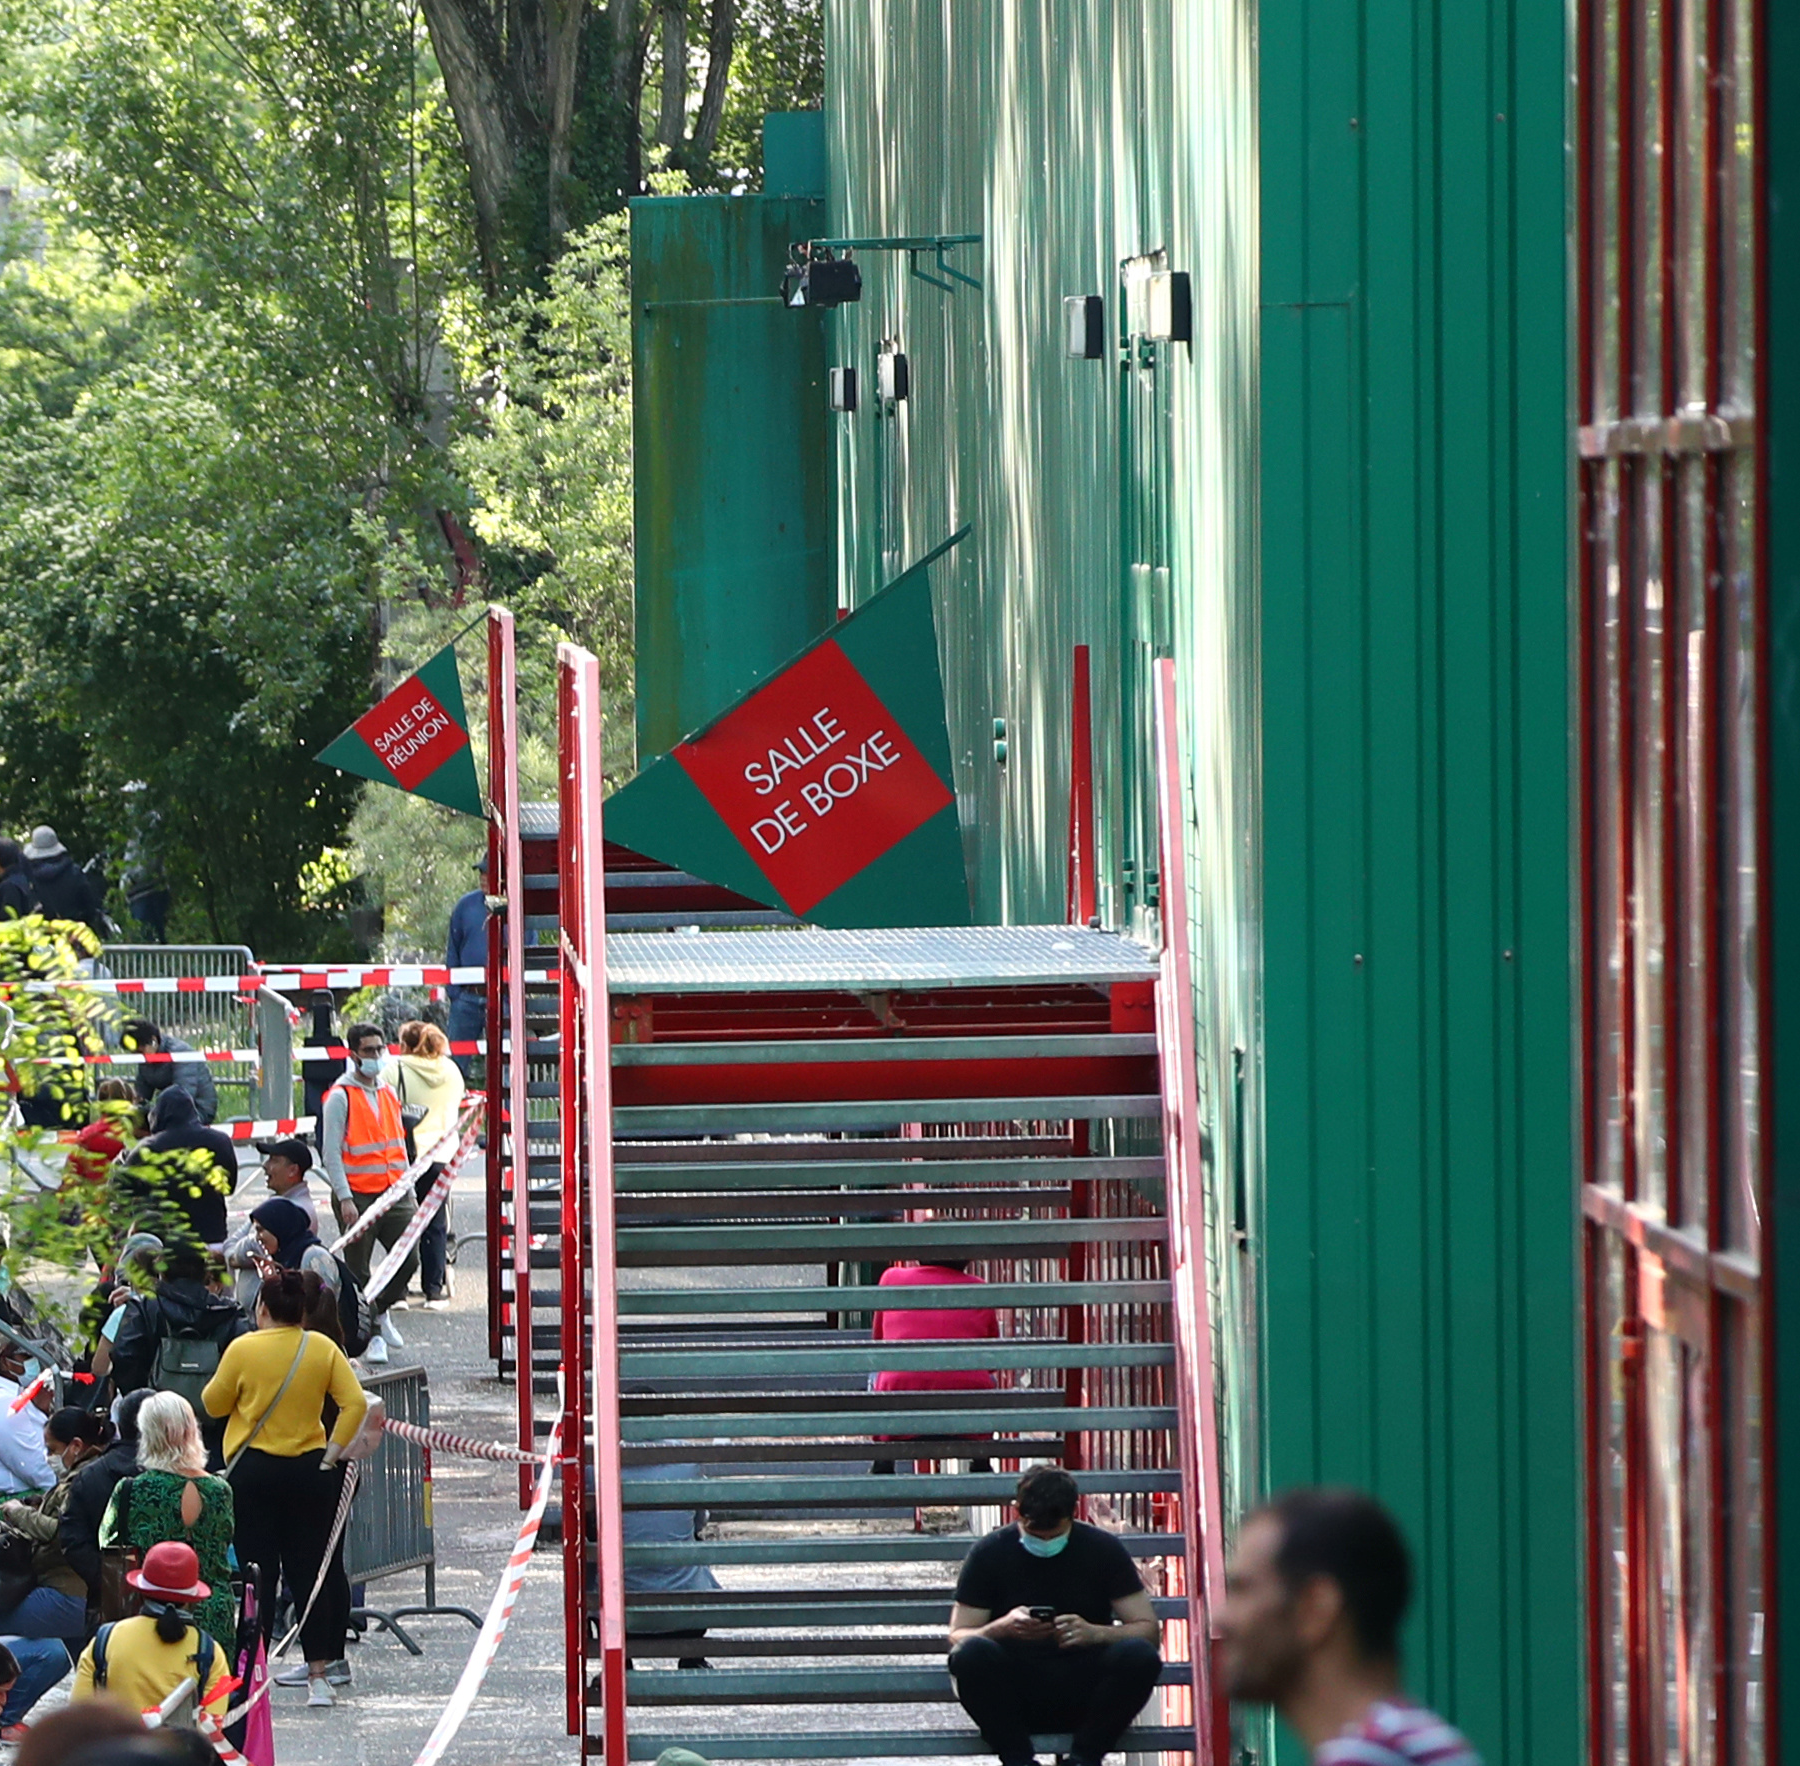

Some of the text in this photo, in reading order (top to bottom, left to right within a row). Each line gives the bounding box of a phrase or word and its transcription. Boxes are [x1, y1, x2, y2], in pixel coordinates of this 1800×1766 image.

[374, 696, 435, 753] SALLE DE
[386, 712, 450, 770] RÉUNION
[744, 707, 847, 795] SALLE
[750, 730, 901, 854] DE BOXE
